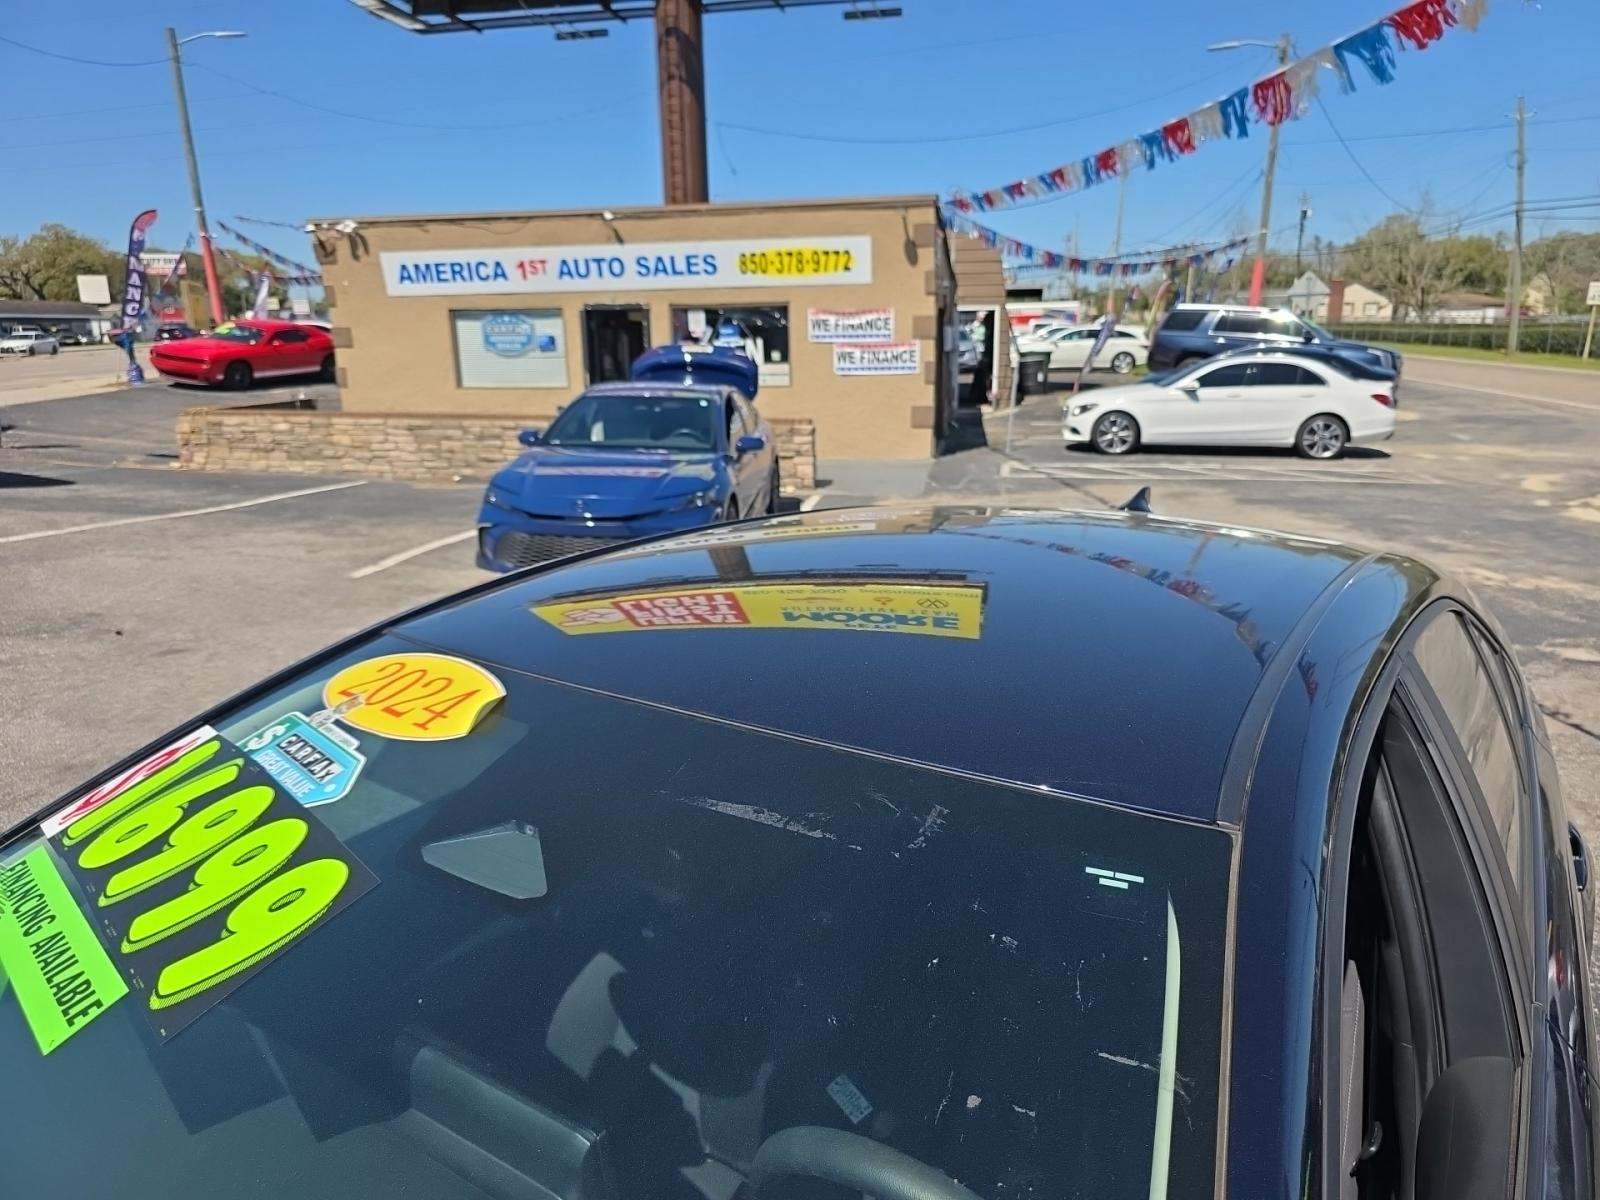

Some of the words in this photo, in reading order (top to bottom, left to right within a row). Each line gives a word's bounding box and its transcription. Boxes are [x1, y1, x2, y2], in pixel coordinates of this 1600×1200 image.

[399, 261, 509, 284] AMERICA
[516, 259, 548, 281] 1ST
[558, 256, 625, 280] AUTO
[636, 254, 718, 277] SALES
[811, 318, 831, 332] WE
[834, 317, 891, 332] FINANCE
[837, 351, 856, 364] WE
[860, 350, 917, 364] FINANCE
[338, 662, 482, 731] 2024
[255, 750, 289, 774] GREAT
[280, 768, 316, 797] VALUE
[278, 734, 336, 782] CARFAX
[4, 859, 57, 938] FINANCING
[29, 930, 105, 1028] AVAILABLE
